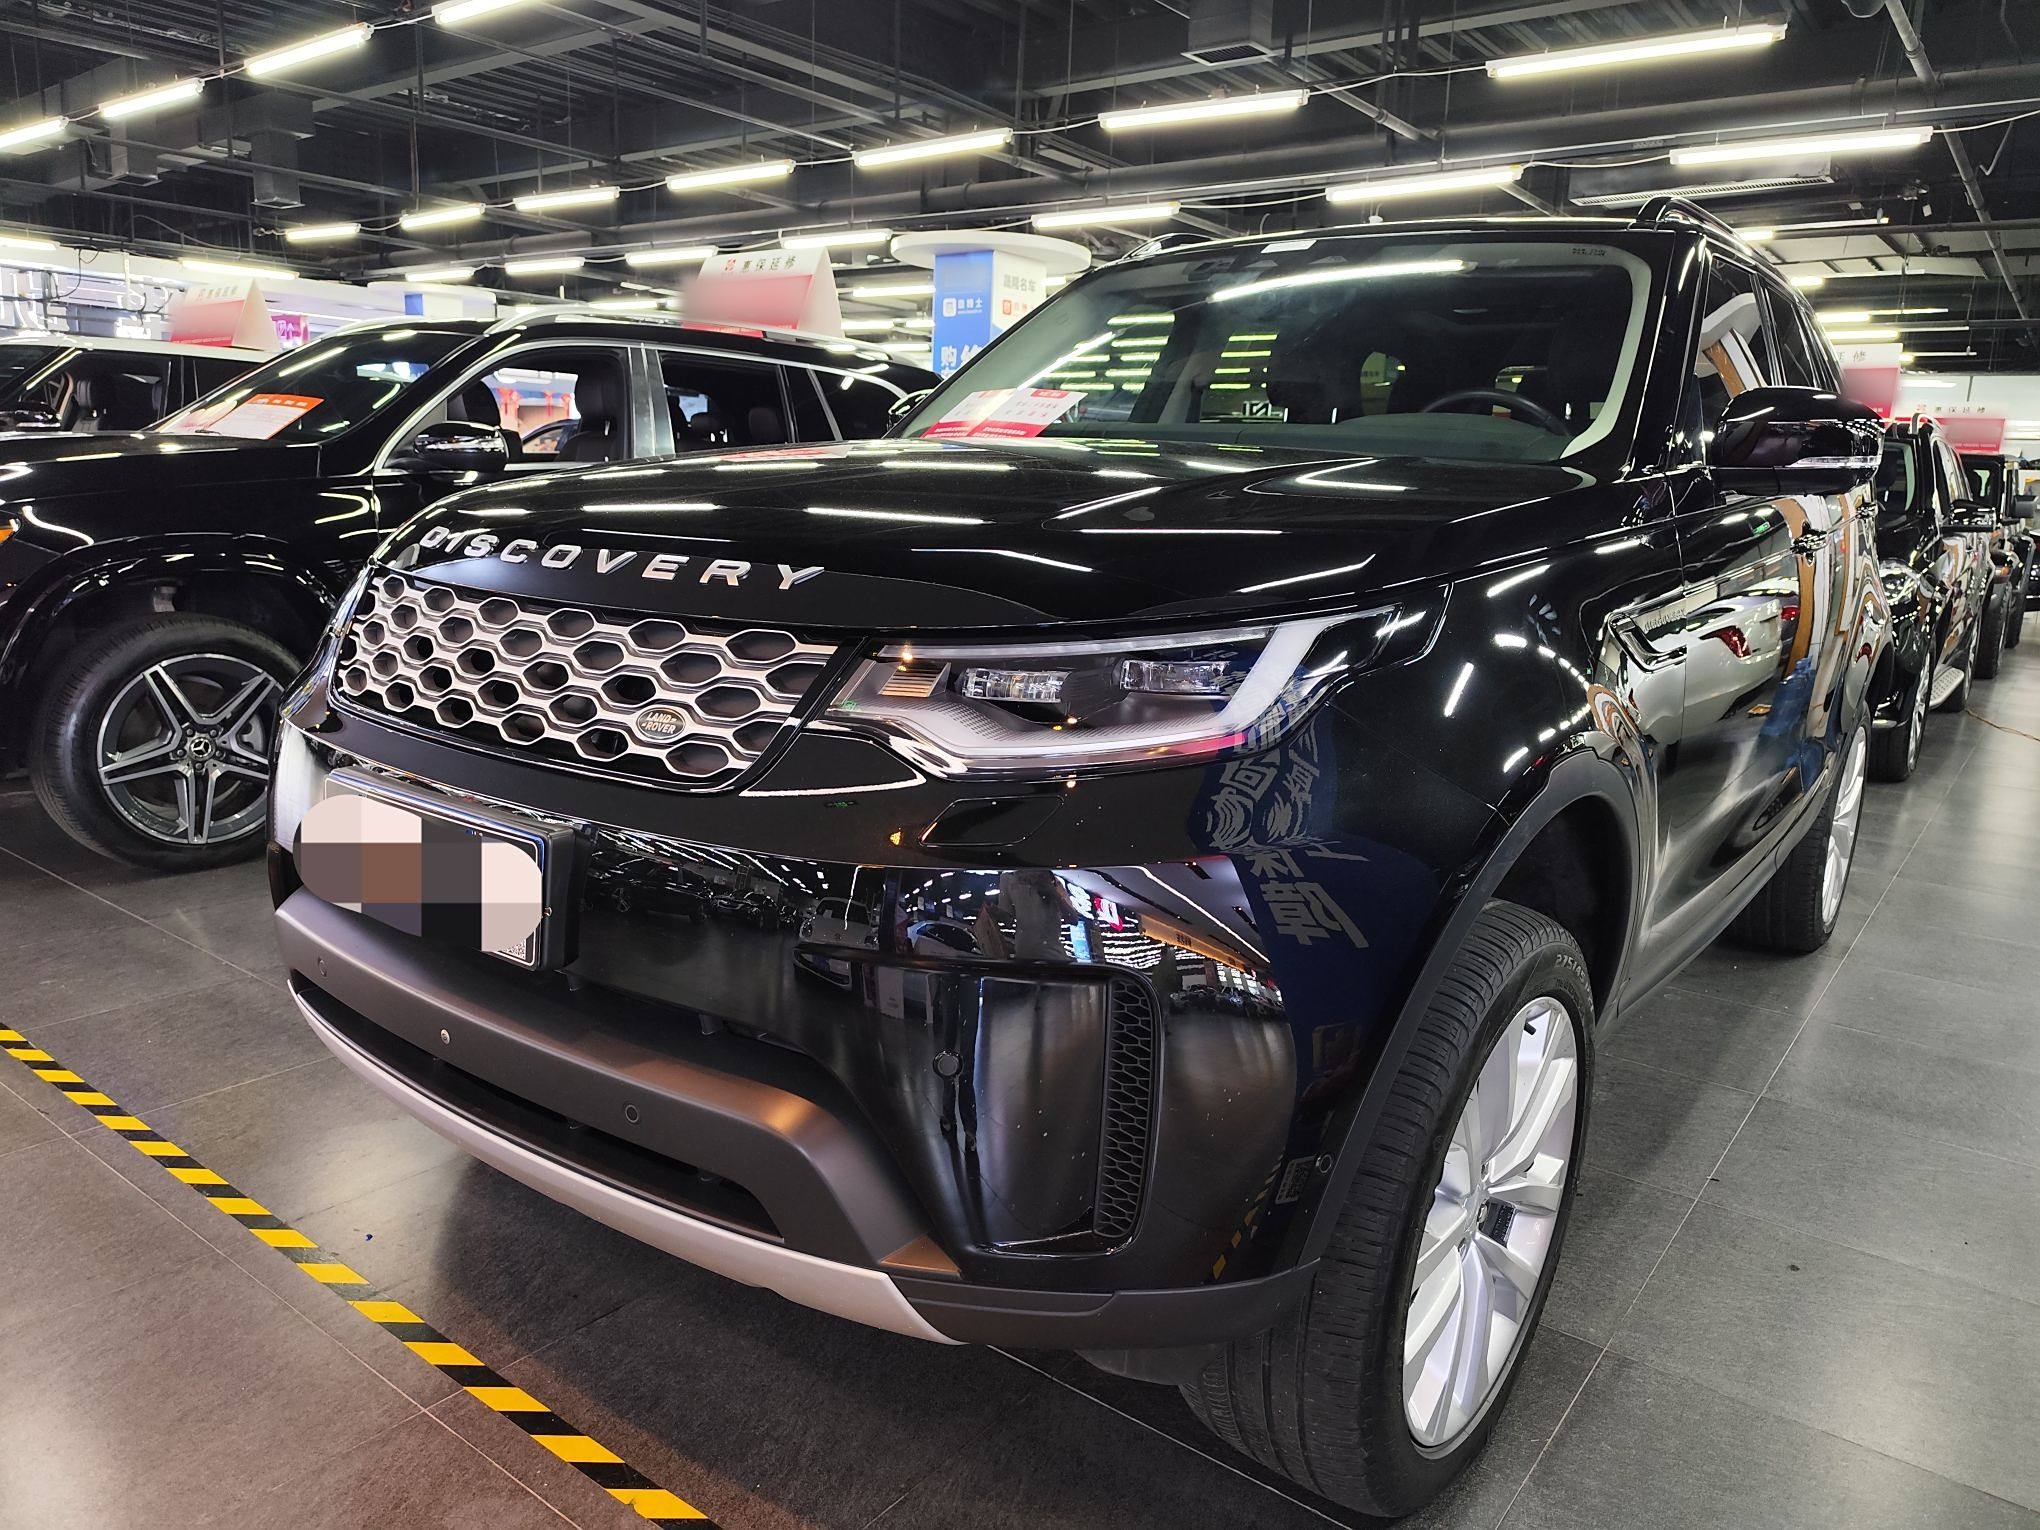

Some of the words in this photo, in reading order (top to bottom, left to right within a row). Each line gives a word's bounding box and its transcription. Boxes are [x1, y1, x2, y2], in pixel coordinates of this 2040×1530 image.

[420, 526, 825, 590] DISCOVERY
[646, 711, 672, 722] LAND
[645, 721, 676, 734] ROVER
